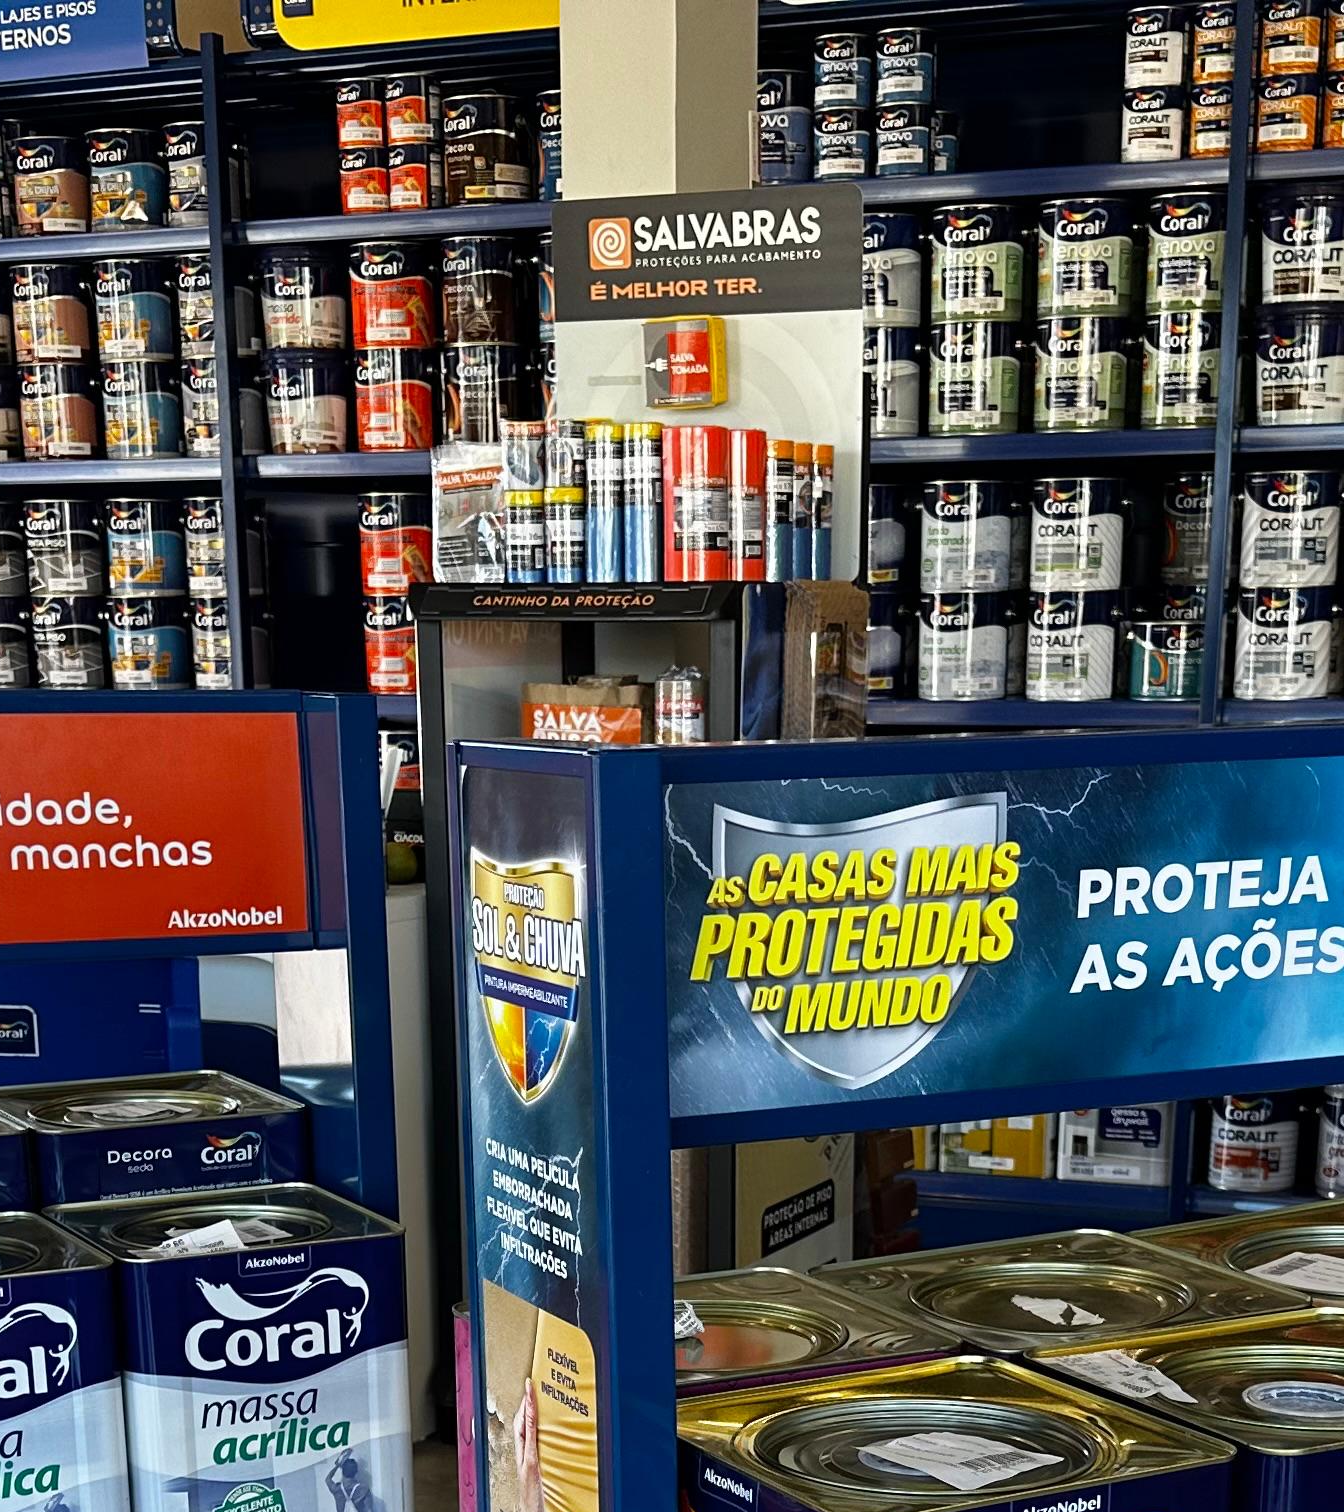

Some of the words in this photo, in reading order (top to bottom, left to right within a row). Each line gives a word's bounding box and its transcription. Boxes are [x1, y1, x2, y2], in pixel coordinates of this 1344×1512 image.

[0, 7, 41, 25] LAJES
[44, 4, 53, 20] E
[55, 0, 97, 18] PISOS
[633, 206, 821, 252] SALVABRAS
[636, 255, 702, 269] PROTEÇÕES
[706, 253, 737, 265] PARA
[741, 250, 822, 264] ACABAMENTO
[1272, 245, 1344, 268] CORALIT
[590, 281, 607, 301] É
[612, 280, 708, 299] MELHOR
[714, 277, 763, 296] TER.
[473, 594, 548, 608] CANTINHO
[551, 594, 572, 608] DA
[575, 593, 654, 609] PROTEÇÃO
[533, 710, 600, 732] SALVA
[10, 834, 213, 872] manchas
[706, 875, 745, 909] AS
[748, 846, 897, 904] CASAS
[908, 840, 1022, 897] MAIS
[503, 881, 544, 911] PROTEÇÃO
[1076, 854, 1330, 919] PROTEJA
[167, 906, 283, 929] AkzoNobel
[472, 896, 503, 957] SOL
[505, 913, 522, 963] &
[523, 913, 586, 978] CHUVA
[689, 895, 1019, 983] PROTEGIDAS
[1069, 941, 1150, 995] AS
[751, 983, 785, 1014] DO
[784, 972, 954, 1036] MUNDO
[107, 1144, 172, 1165] Decora
[201, 1144, 253, 1165] Coral
[1218, 1127, 1277, 1143] CORALIT
[485, 1138, 506, 1161] CRIA
[508, 1146, 530, 1172] UMA
[531, 1156, 580, 1192] PELÍCULA
[493, 1169, 573, 1221] EMBORRACHADA
[764, 1198, 804, 1227] PROTEÇÃO
[806, 1195, 815, 1209] DE
[816, 1186, 832, 1205] PISO
[487, 1195, 529, 1231] FLEXÍVEL
[529, 1216, 551, 1241] QUE
[552, 1226, 583, 1256] EVITA
[501, 1231, 568, 1279] INFILTRAÇÕES
[184, 1307, 343, 1373] Coral
[200, 1385, 320, 1430] massa
[212, 1416, 351, 1466] acrílica
